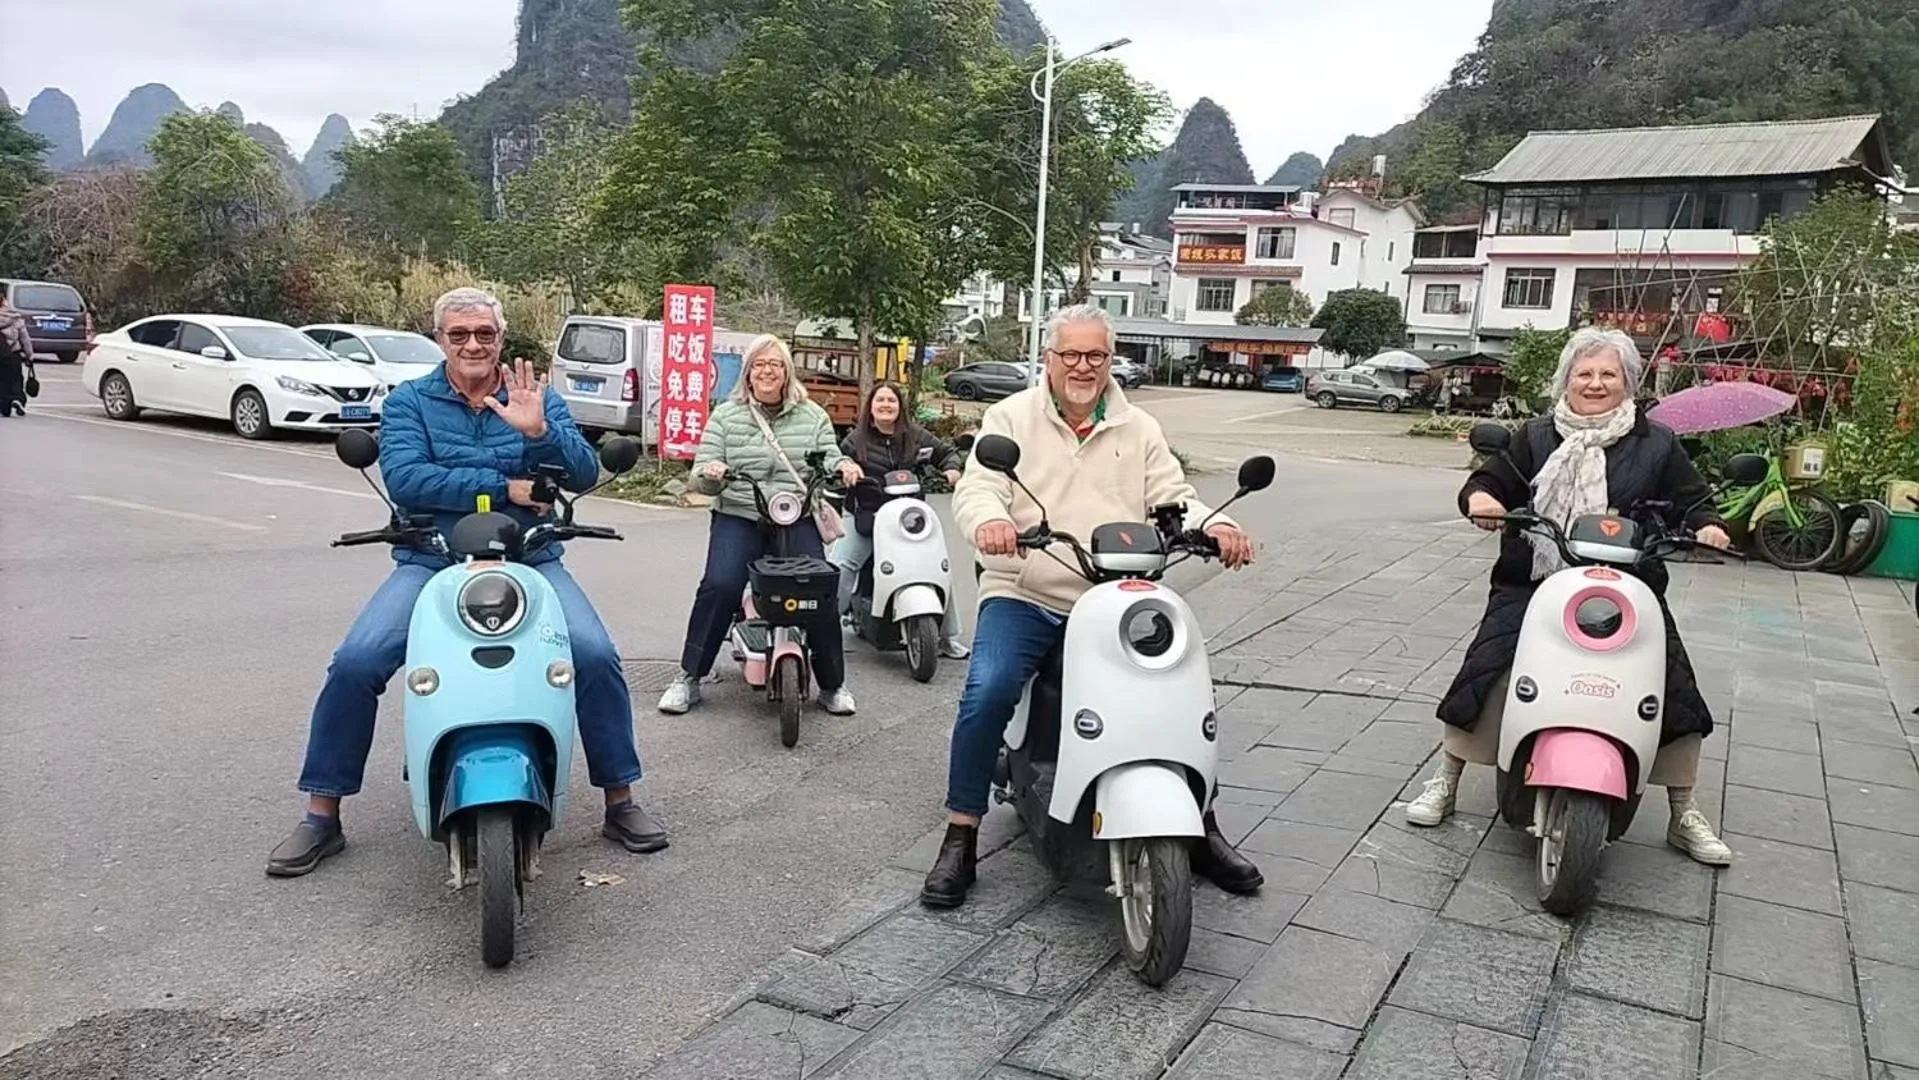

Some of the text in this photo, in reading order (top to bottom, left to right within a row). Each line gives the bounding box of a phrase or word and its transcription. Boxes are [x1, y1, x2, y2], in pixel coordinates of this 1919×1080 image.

[669, 293, 707, 327] 租车
[667, 332, 706, 365] 吃饭
[666, 368, 704, 401] 免费
[664, 406, 702, 441] 停车
[1571, 680, 1615, 698] Oasis
